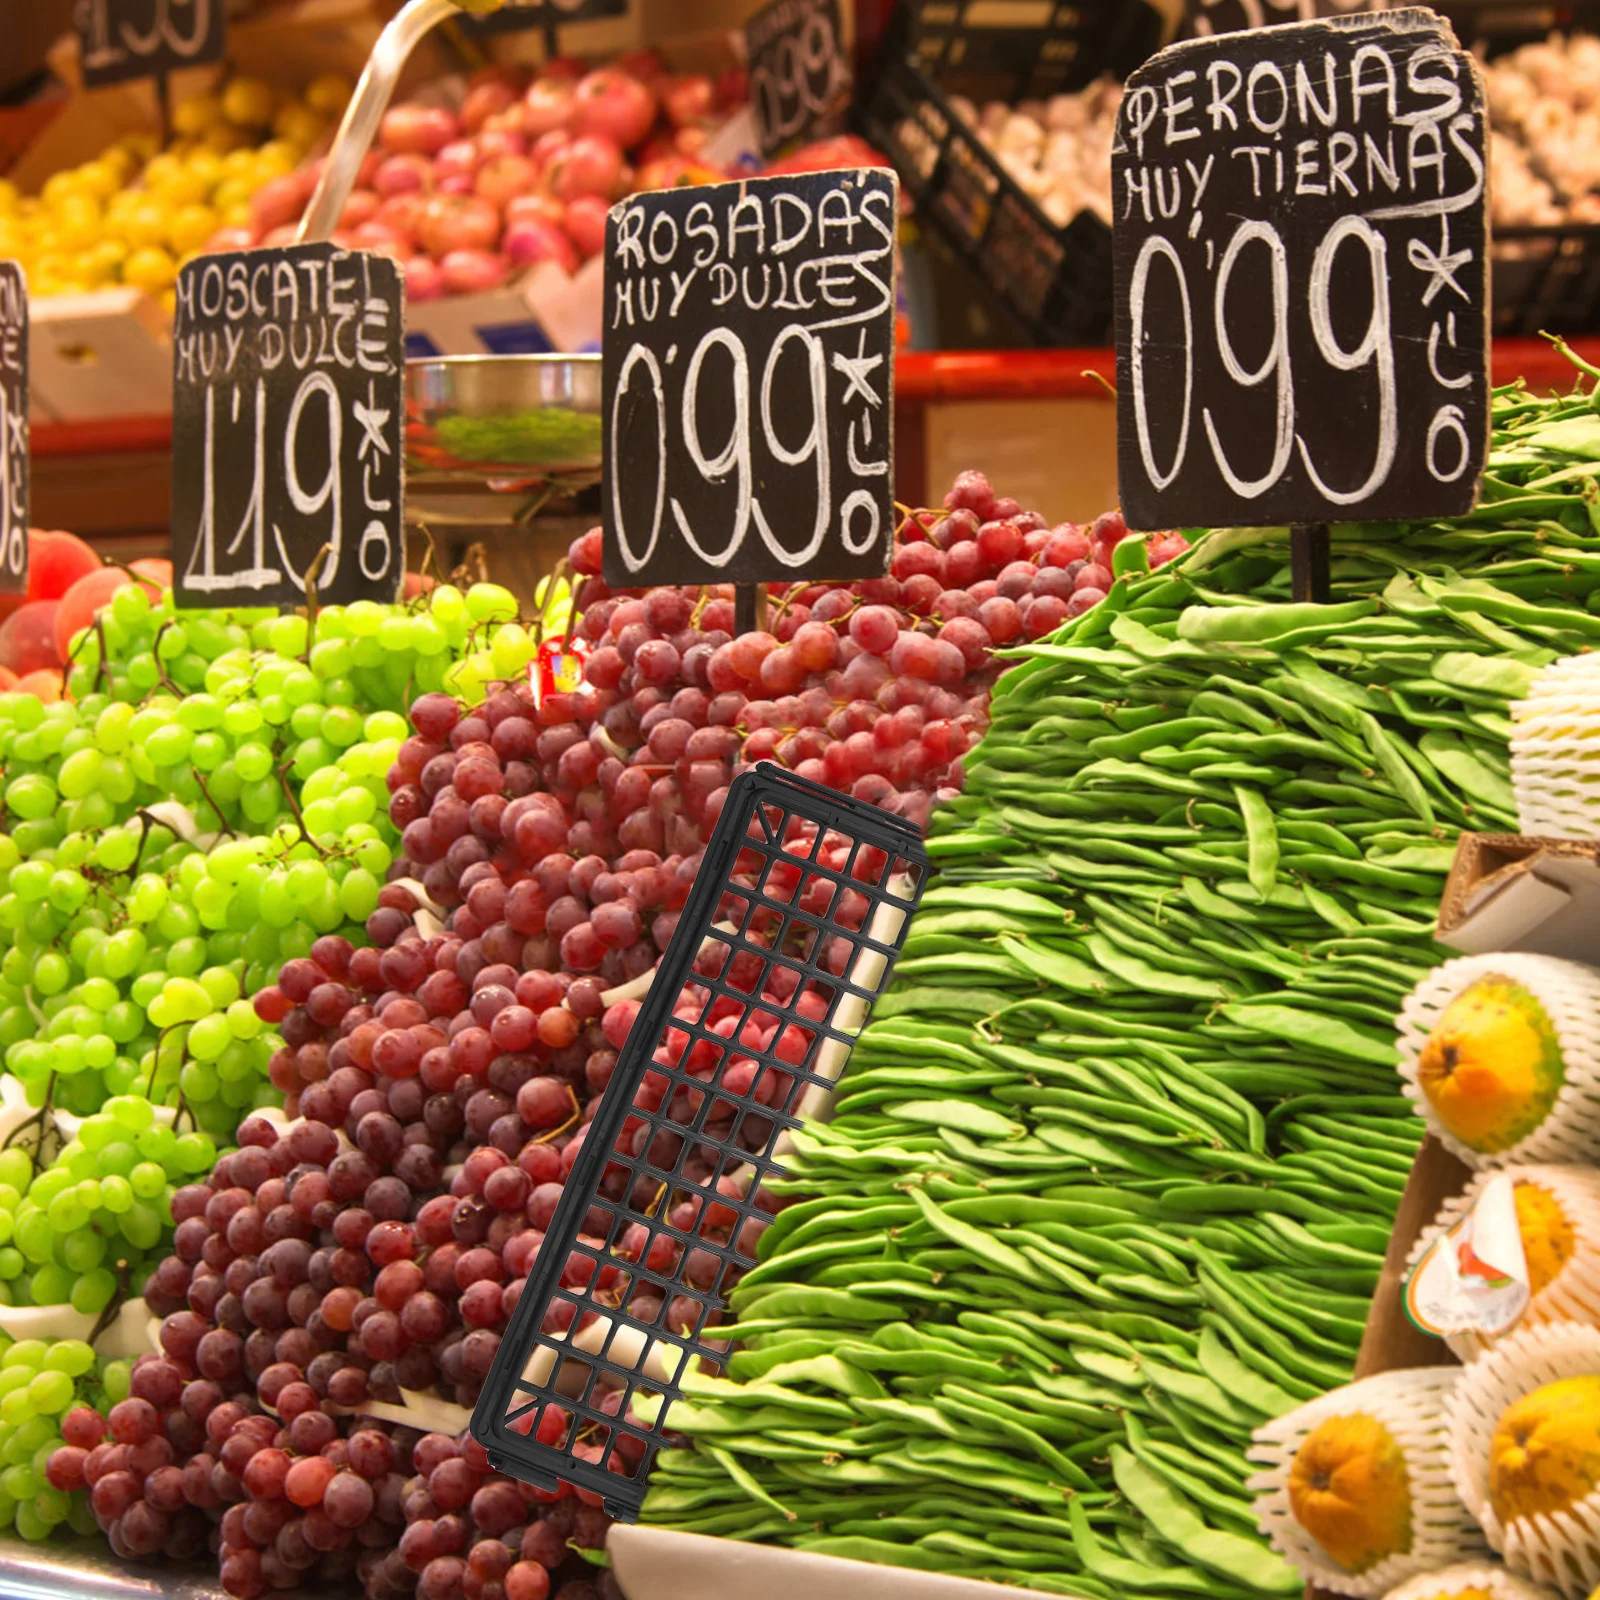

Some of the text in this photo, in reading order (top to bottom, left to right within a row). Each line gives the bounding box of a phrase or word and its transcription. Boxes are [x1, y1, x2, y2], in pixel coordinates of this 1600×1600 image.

[1126, 44, 1462, 160] PERONAS
[1124, 154, 1214, 224] MUY
[615, 188, 893, 270] ROSADAS
[611, 257, 893, 329] MUY DULCES
[176, 311, 397, 383] MUY DULCE
[611, 324, 831, 573] 0'99
